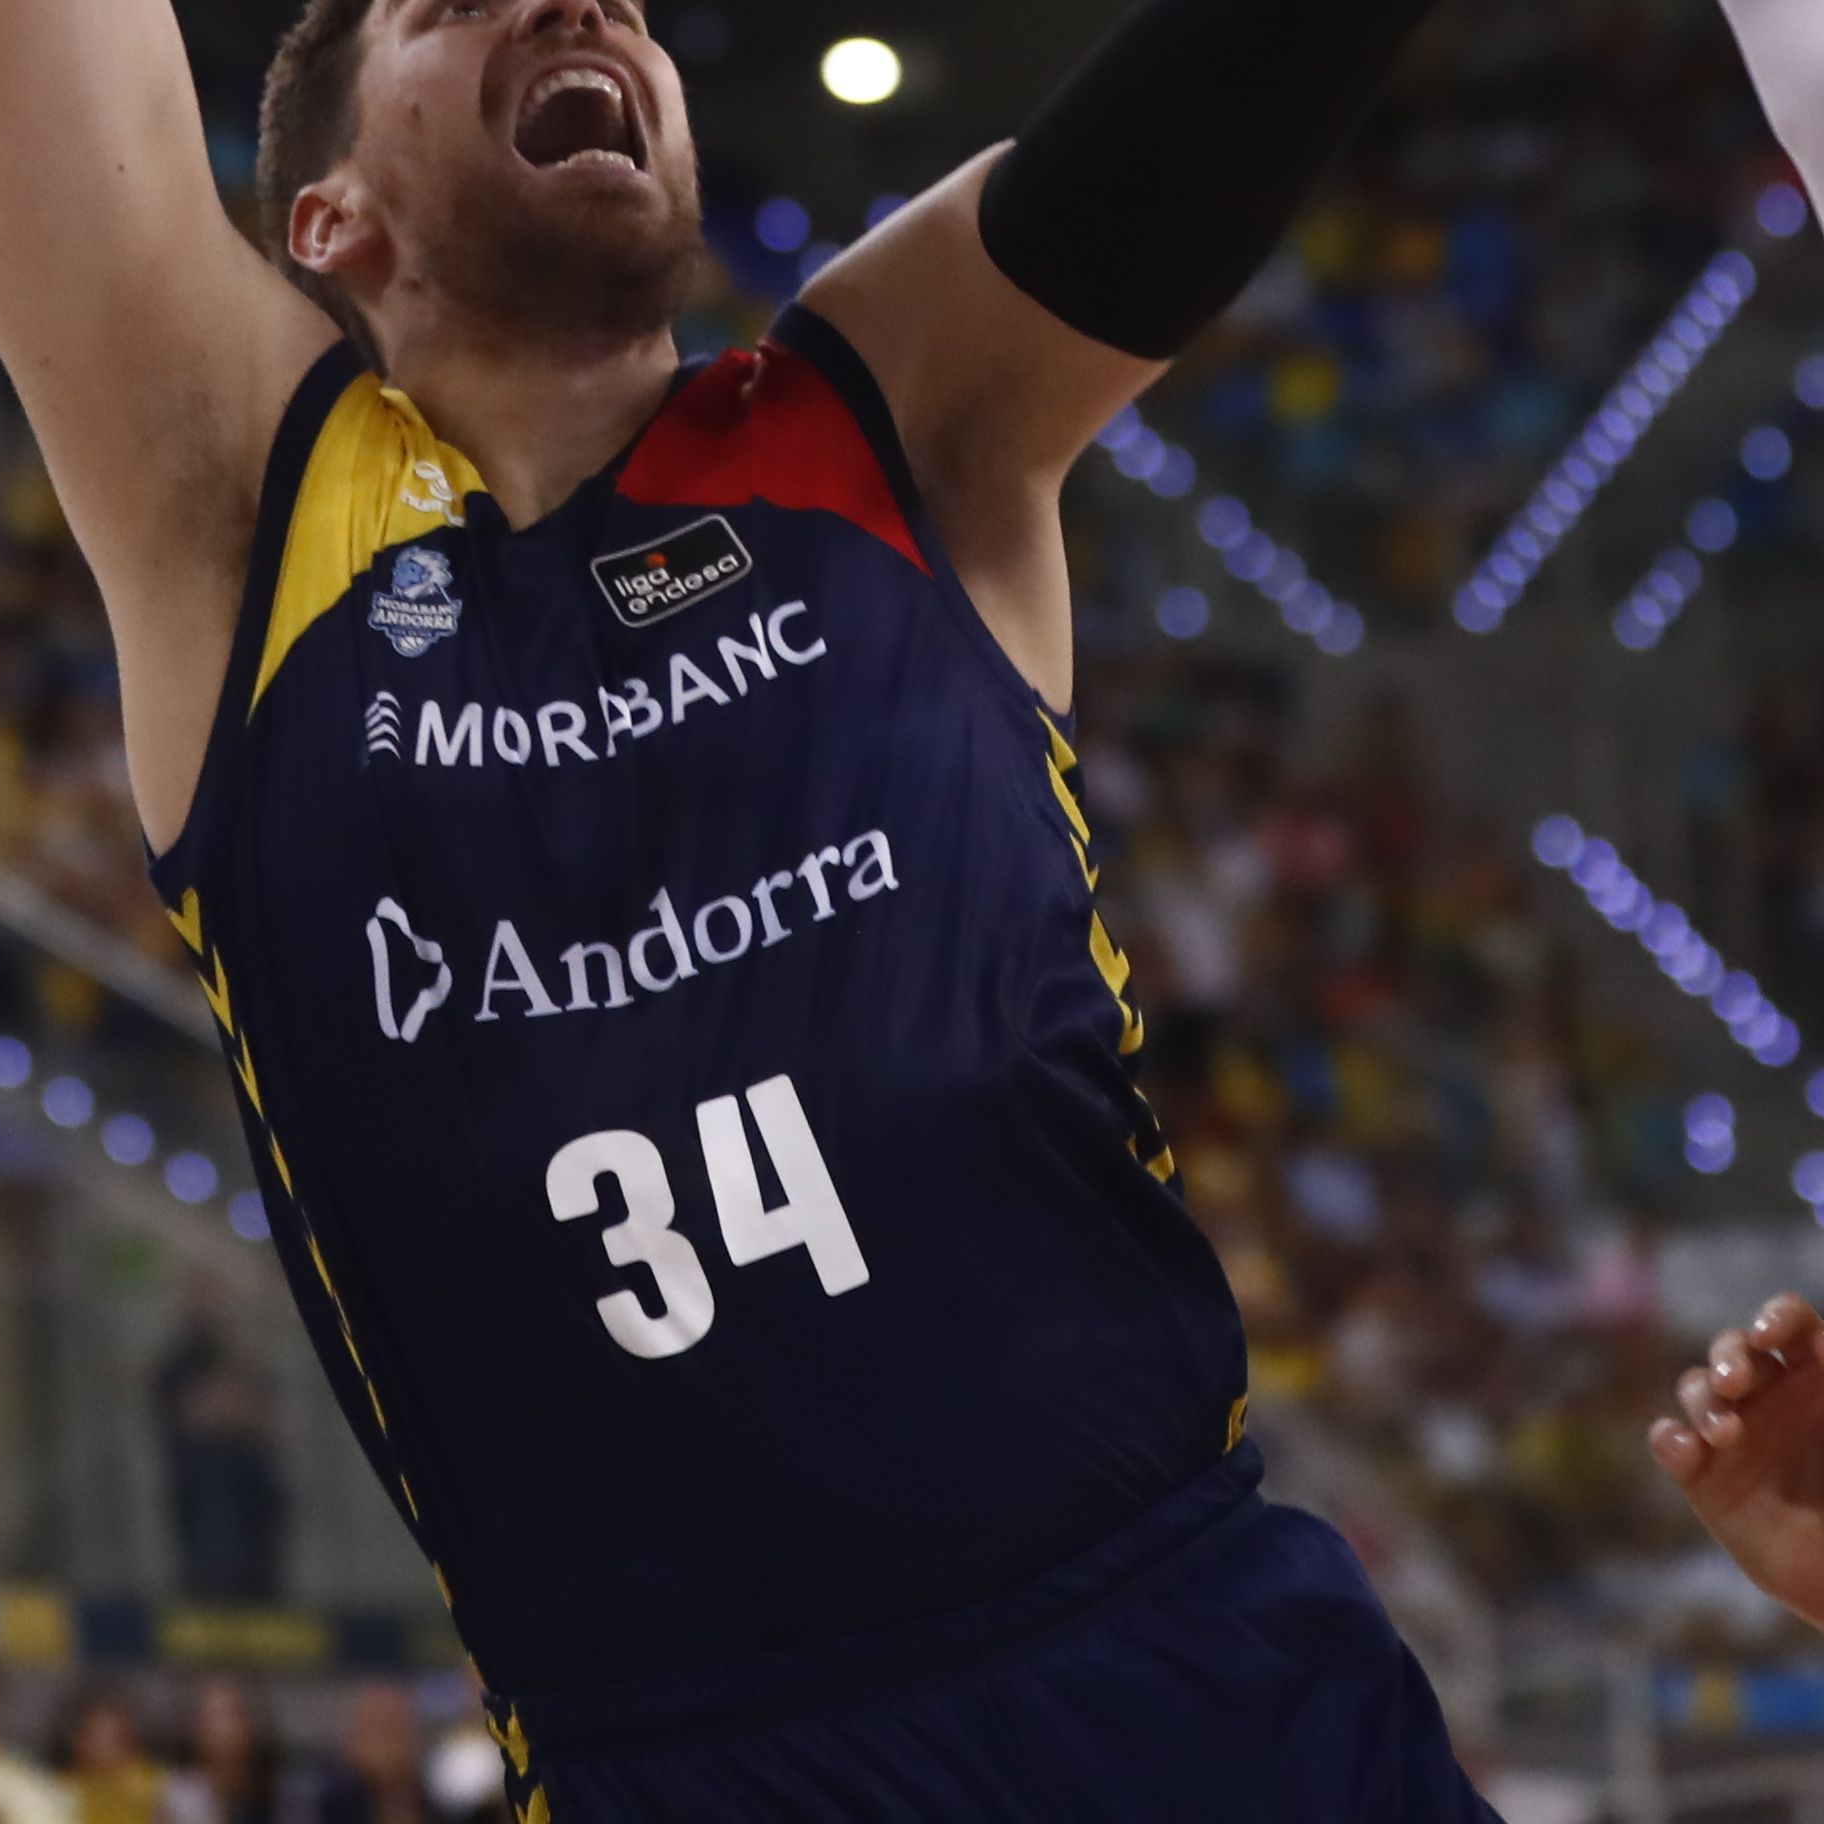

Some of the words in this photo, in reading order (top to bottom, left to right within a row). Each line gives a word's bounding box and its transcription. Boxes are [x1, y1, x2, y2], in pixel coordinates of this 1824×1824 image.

[377, 596, 456, 616] MORABANC
[613, 566, 672, 599] liga
[627, 553, 740, 615] endesa
[375, 608, 454, 630] ANDORRA
[413, 599, 828, 768] MORABANC
[474, 828, 900, 1022] Andorra
[545, 1073, 871, 1360] 34
